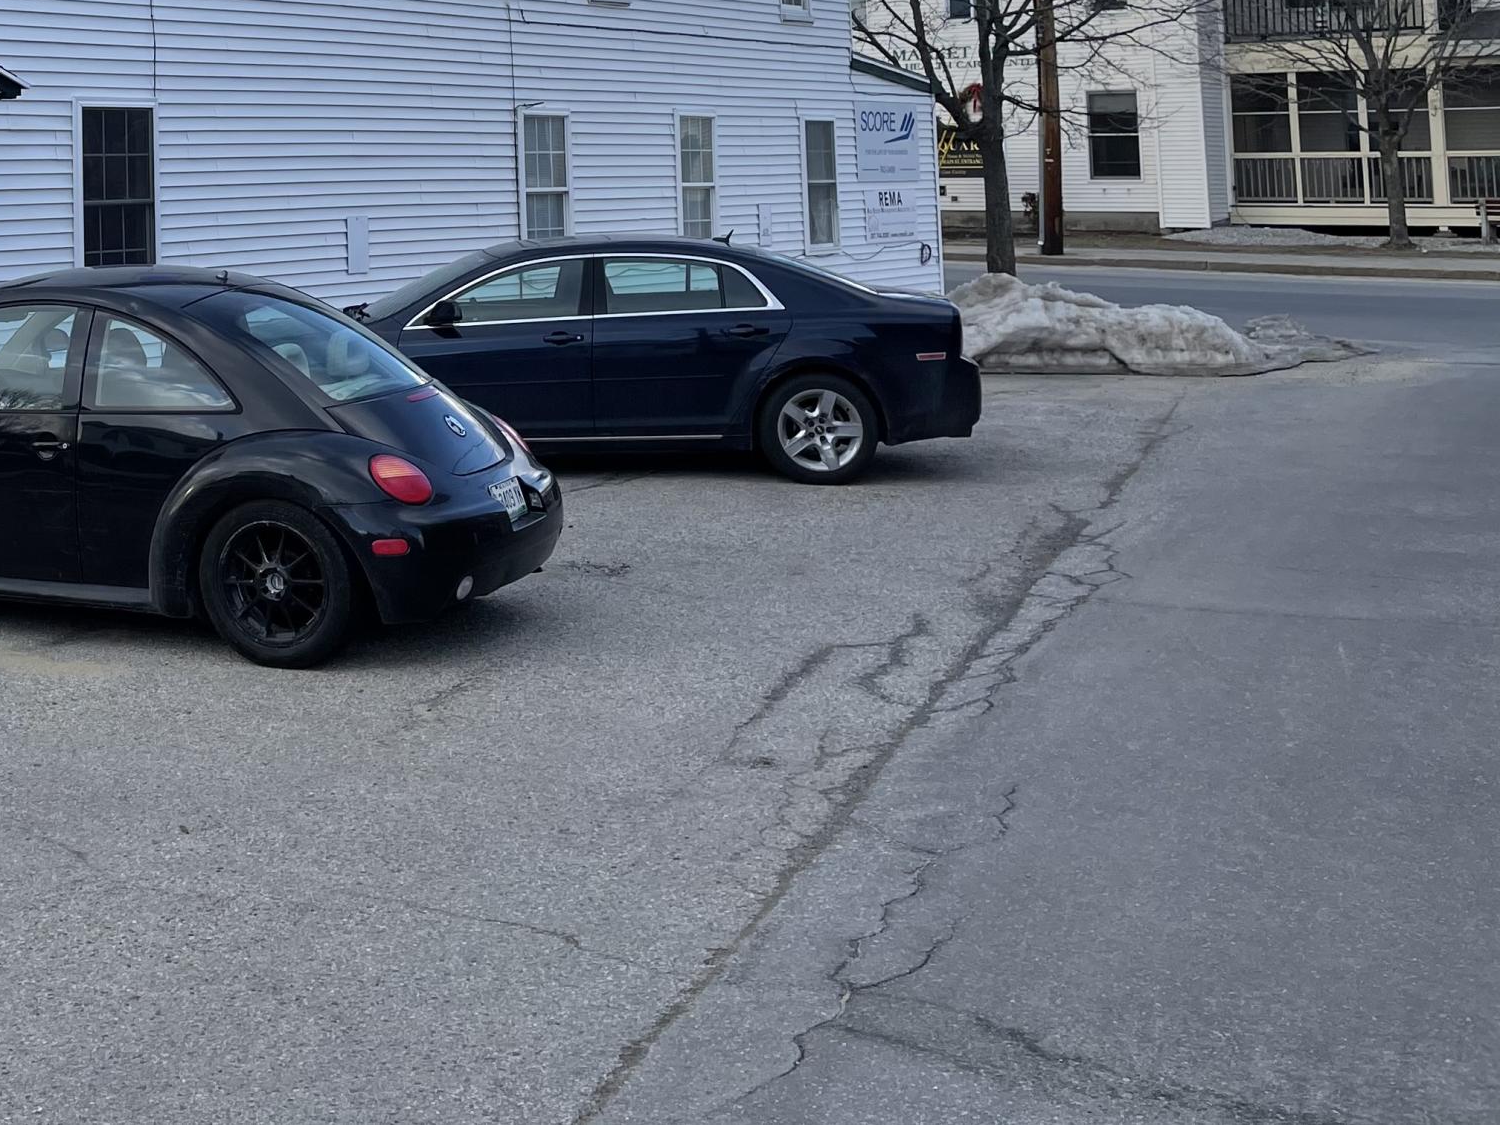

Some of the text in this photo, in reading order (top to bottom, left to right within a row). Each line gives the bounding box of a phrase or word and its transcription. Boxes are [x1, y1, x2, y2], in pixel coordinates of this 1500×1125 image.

[893, 46, 972, 62] MAET
[956, 60, 981, 69] CAR
[860, 110, 896, 132] SCORE
[878, 190, 903, 206] REMA
